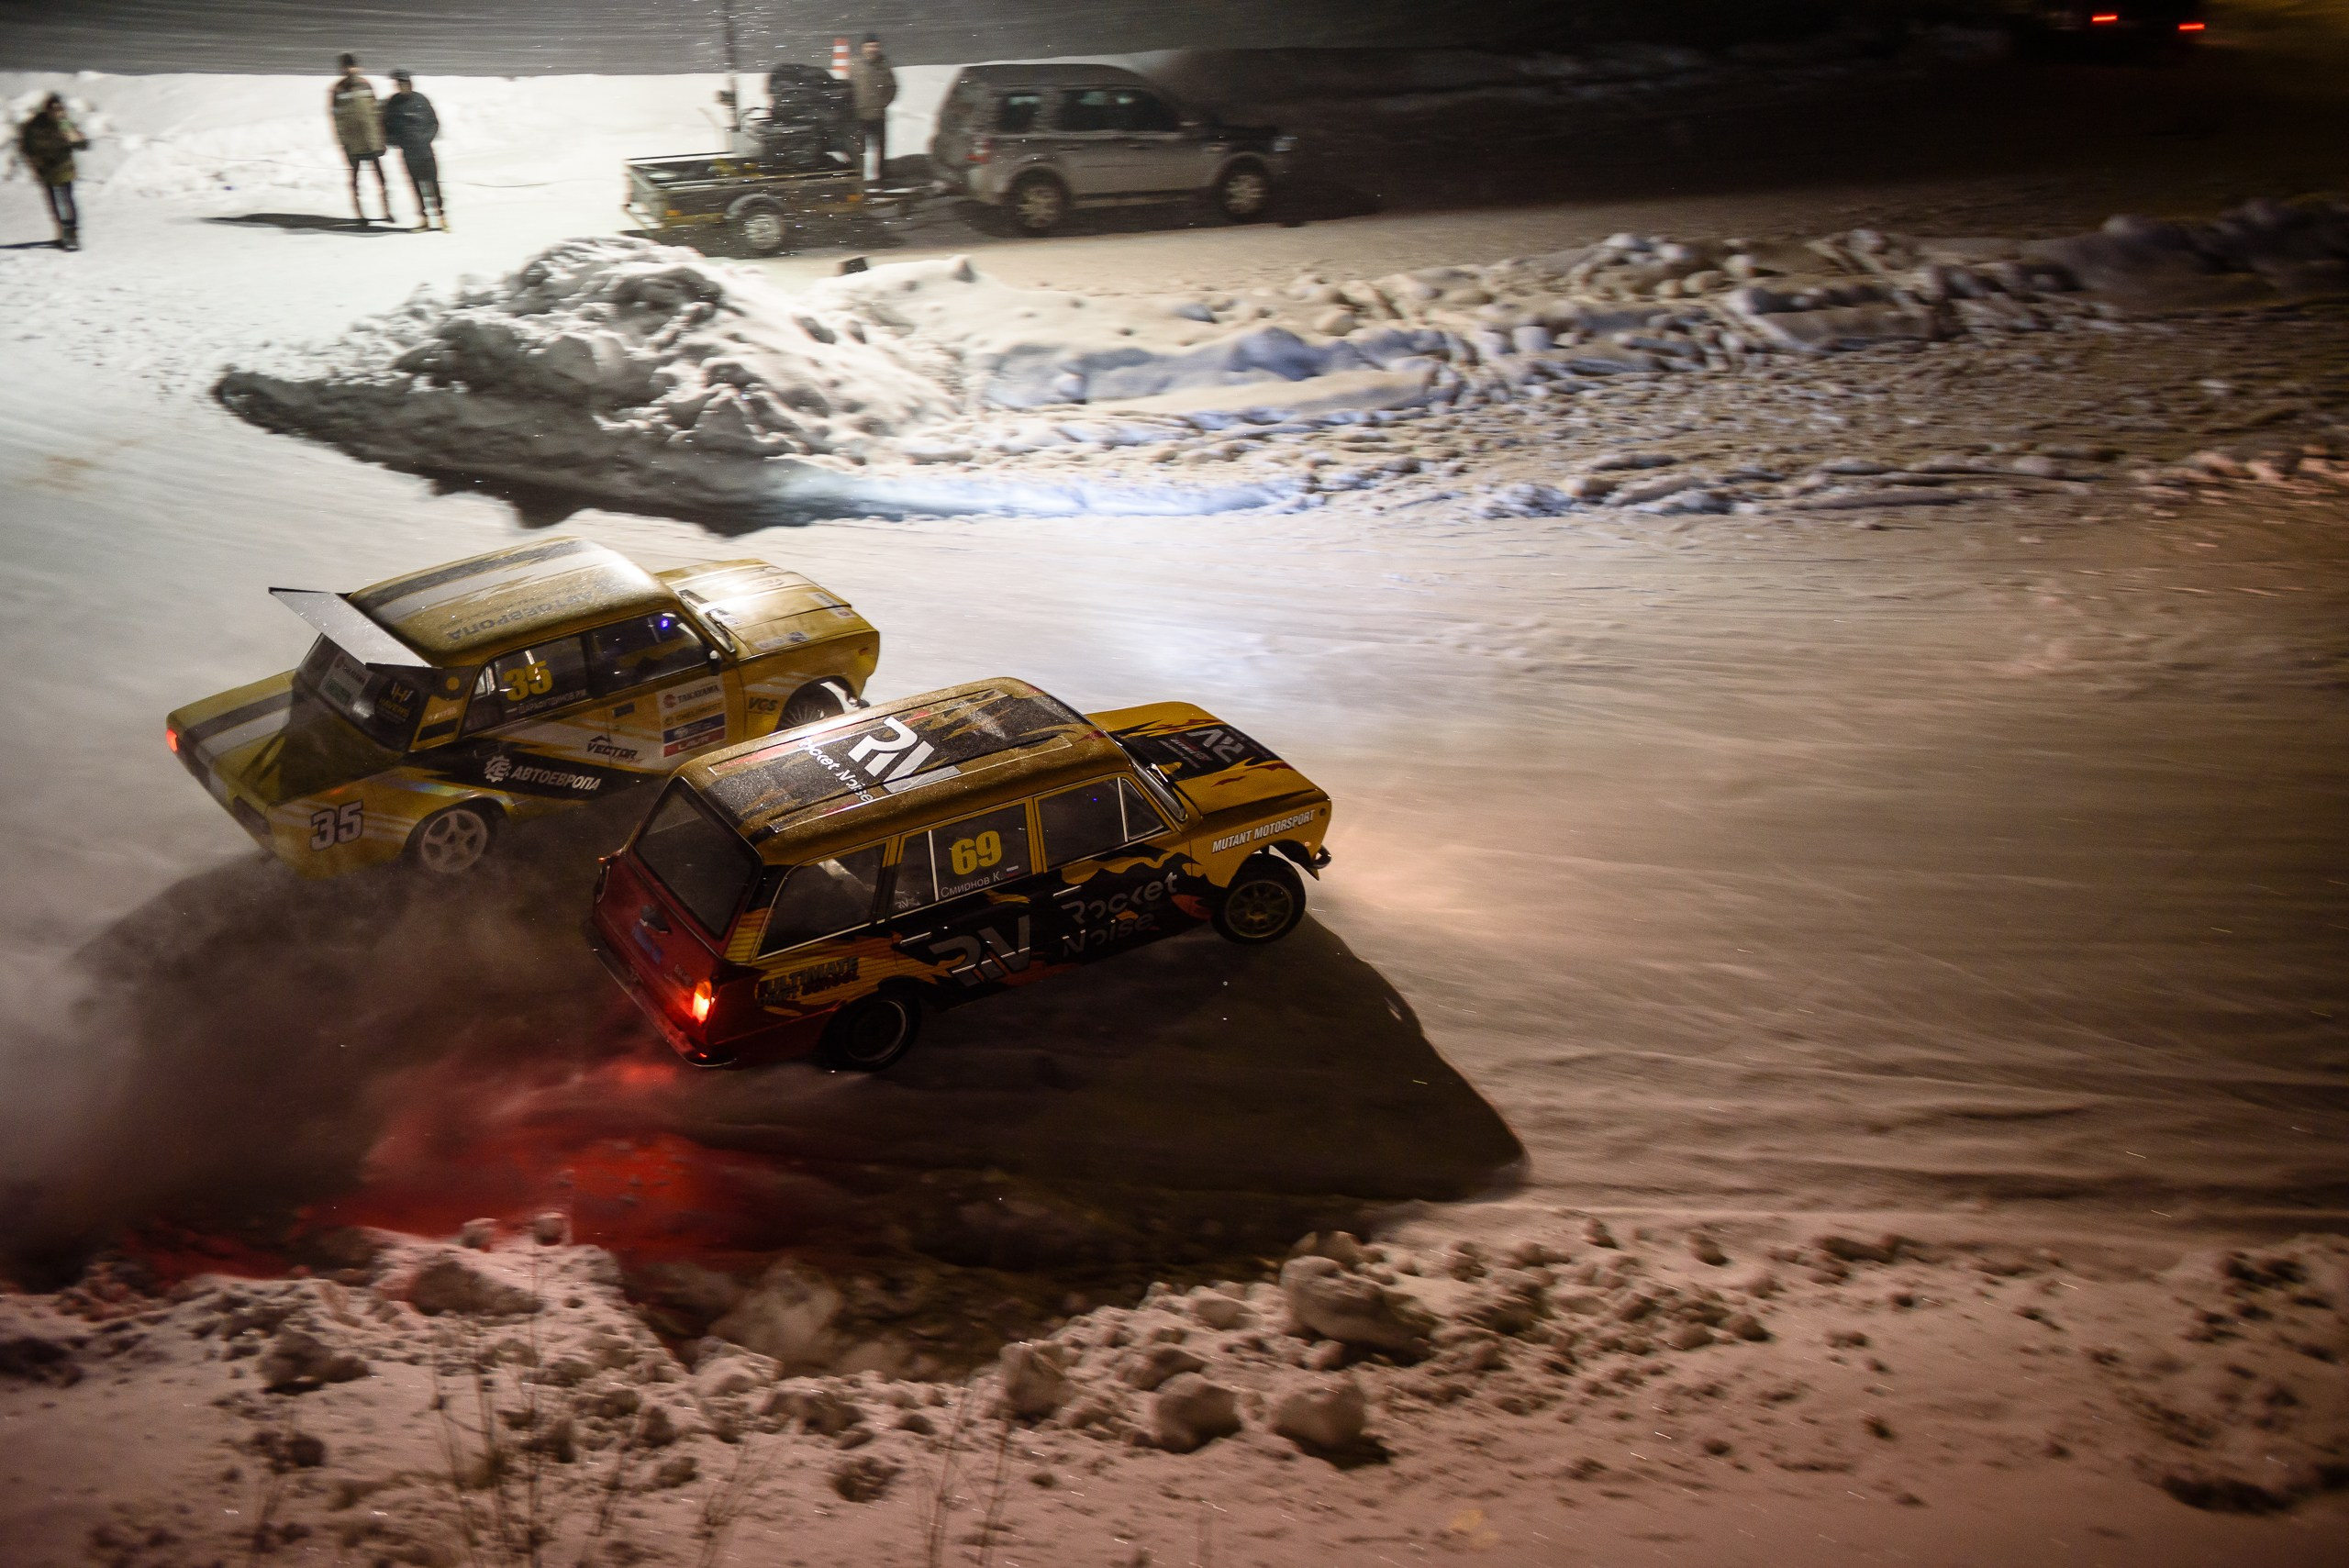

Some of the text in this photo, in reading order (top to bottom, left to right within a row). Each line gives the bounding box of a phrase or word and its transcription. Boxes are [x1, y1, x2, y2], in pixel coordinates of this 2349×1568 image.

[503, 660, 553, 702] 35
[678, 684, 719, 703] TAKAYAMA
[587, 741, 639, 760] VECTOR
[509, 765, 602, 791] АВТОЕВРОПА
[310, 799, 364, 851] 35
[1211, 809, 1316, 853] MUTANT MOTORSPORT
[951, 830, 1003, 876] 69
[941, 875, 990, 898] Смирнов
[1060, 872, 1178, 925] Rocket
[1062, 912, 1155, 957] Noise
